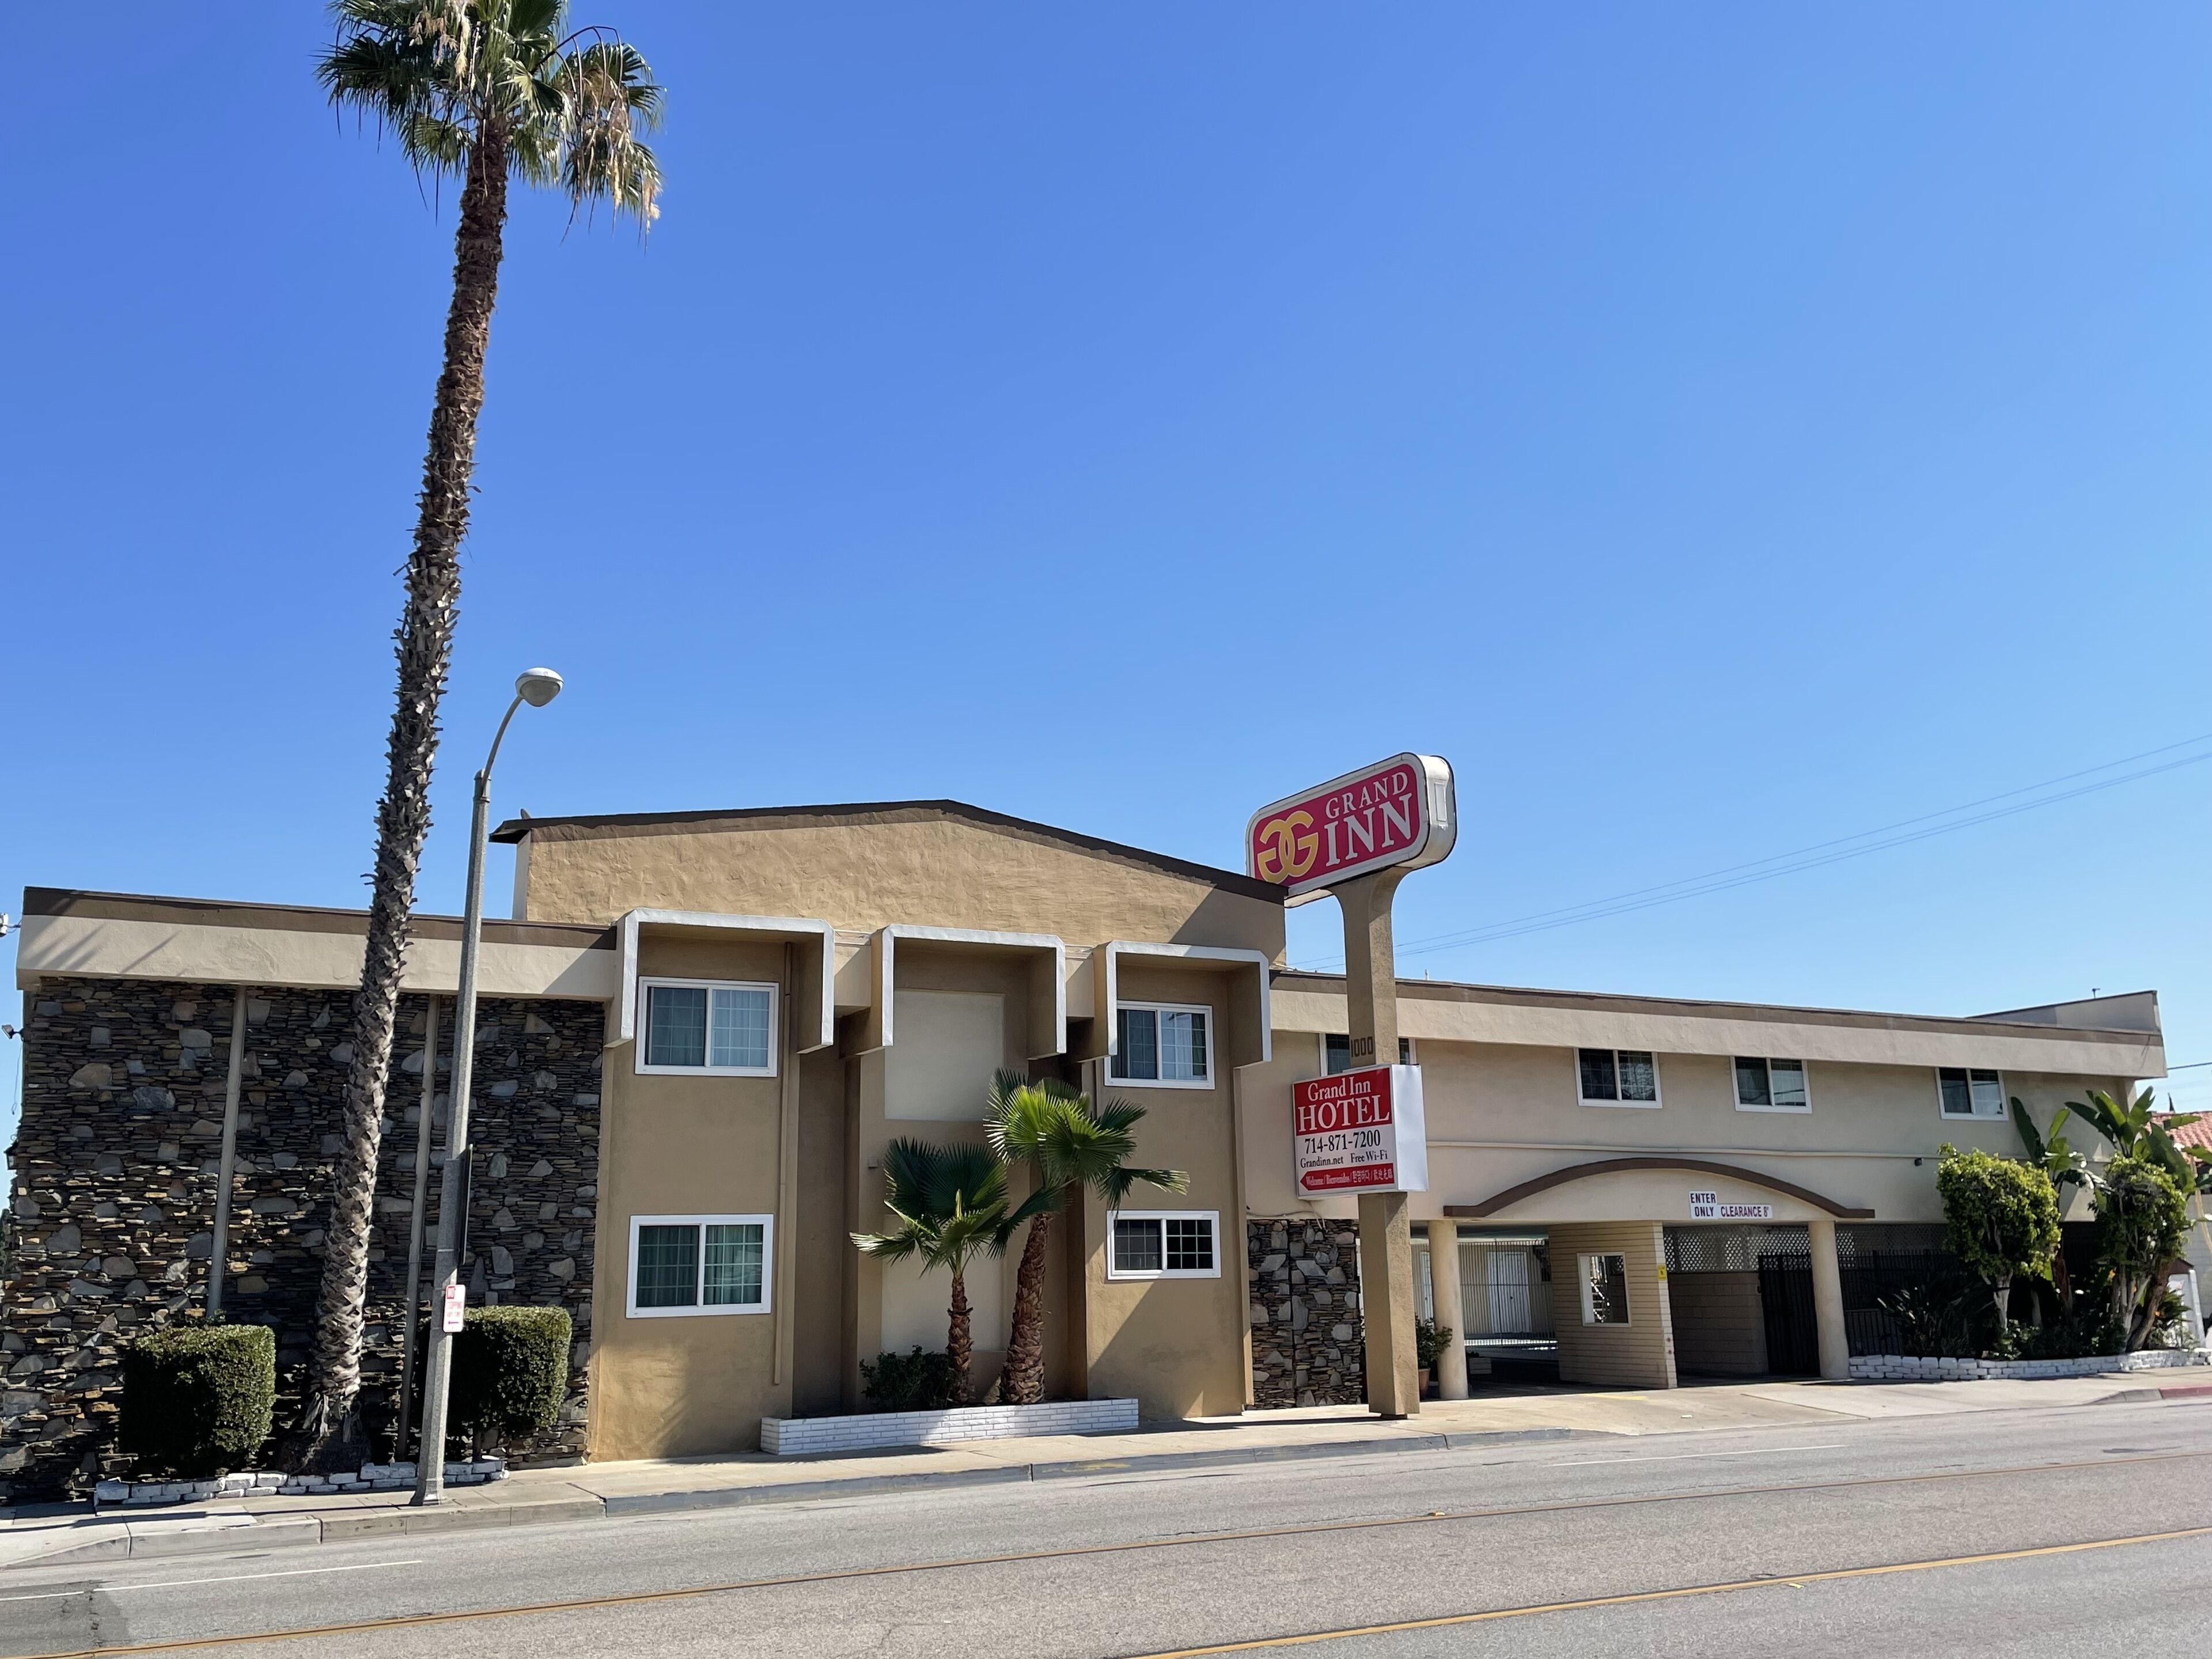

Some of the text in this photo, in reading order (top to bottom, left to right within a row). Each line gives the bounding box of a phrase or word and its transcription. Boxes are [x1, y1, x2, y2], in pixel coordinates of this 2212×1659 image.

[1326, 772, 1408, 819] GRAND
[1324, 793, 1412, 866] INN
[1351, 1037, 1373, 1058] 1000
[1308, 1077, 1371, 1101] Grand Inn
[1298, 1095, 1390, 1132] HOTEL
[1305, 1130, 1381, 1154] 714-871-7200
[1300, 1150, 1388, 1168] Grandinn.net Free Wi-Fi
[1690, 1193, 1716, 1203] ENTER
[1695, 1206, 1714, 1217] ONLY
[1721, 1206, 1762, 1217] CLEARANCE
